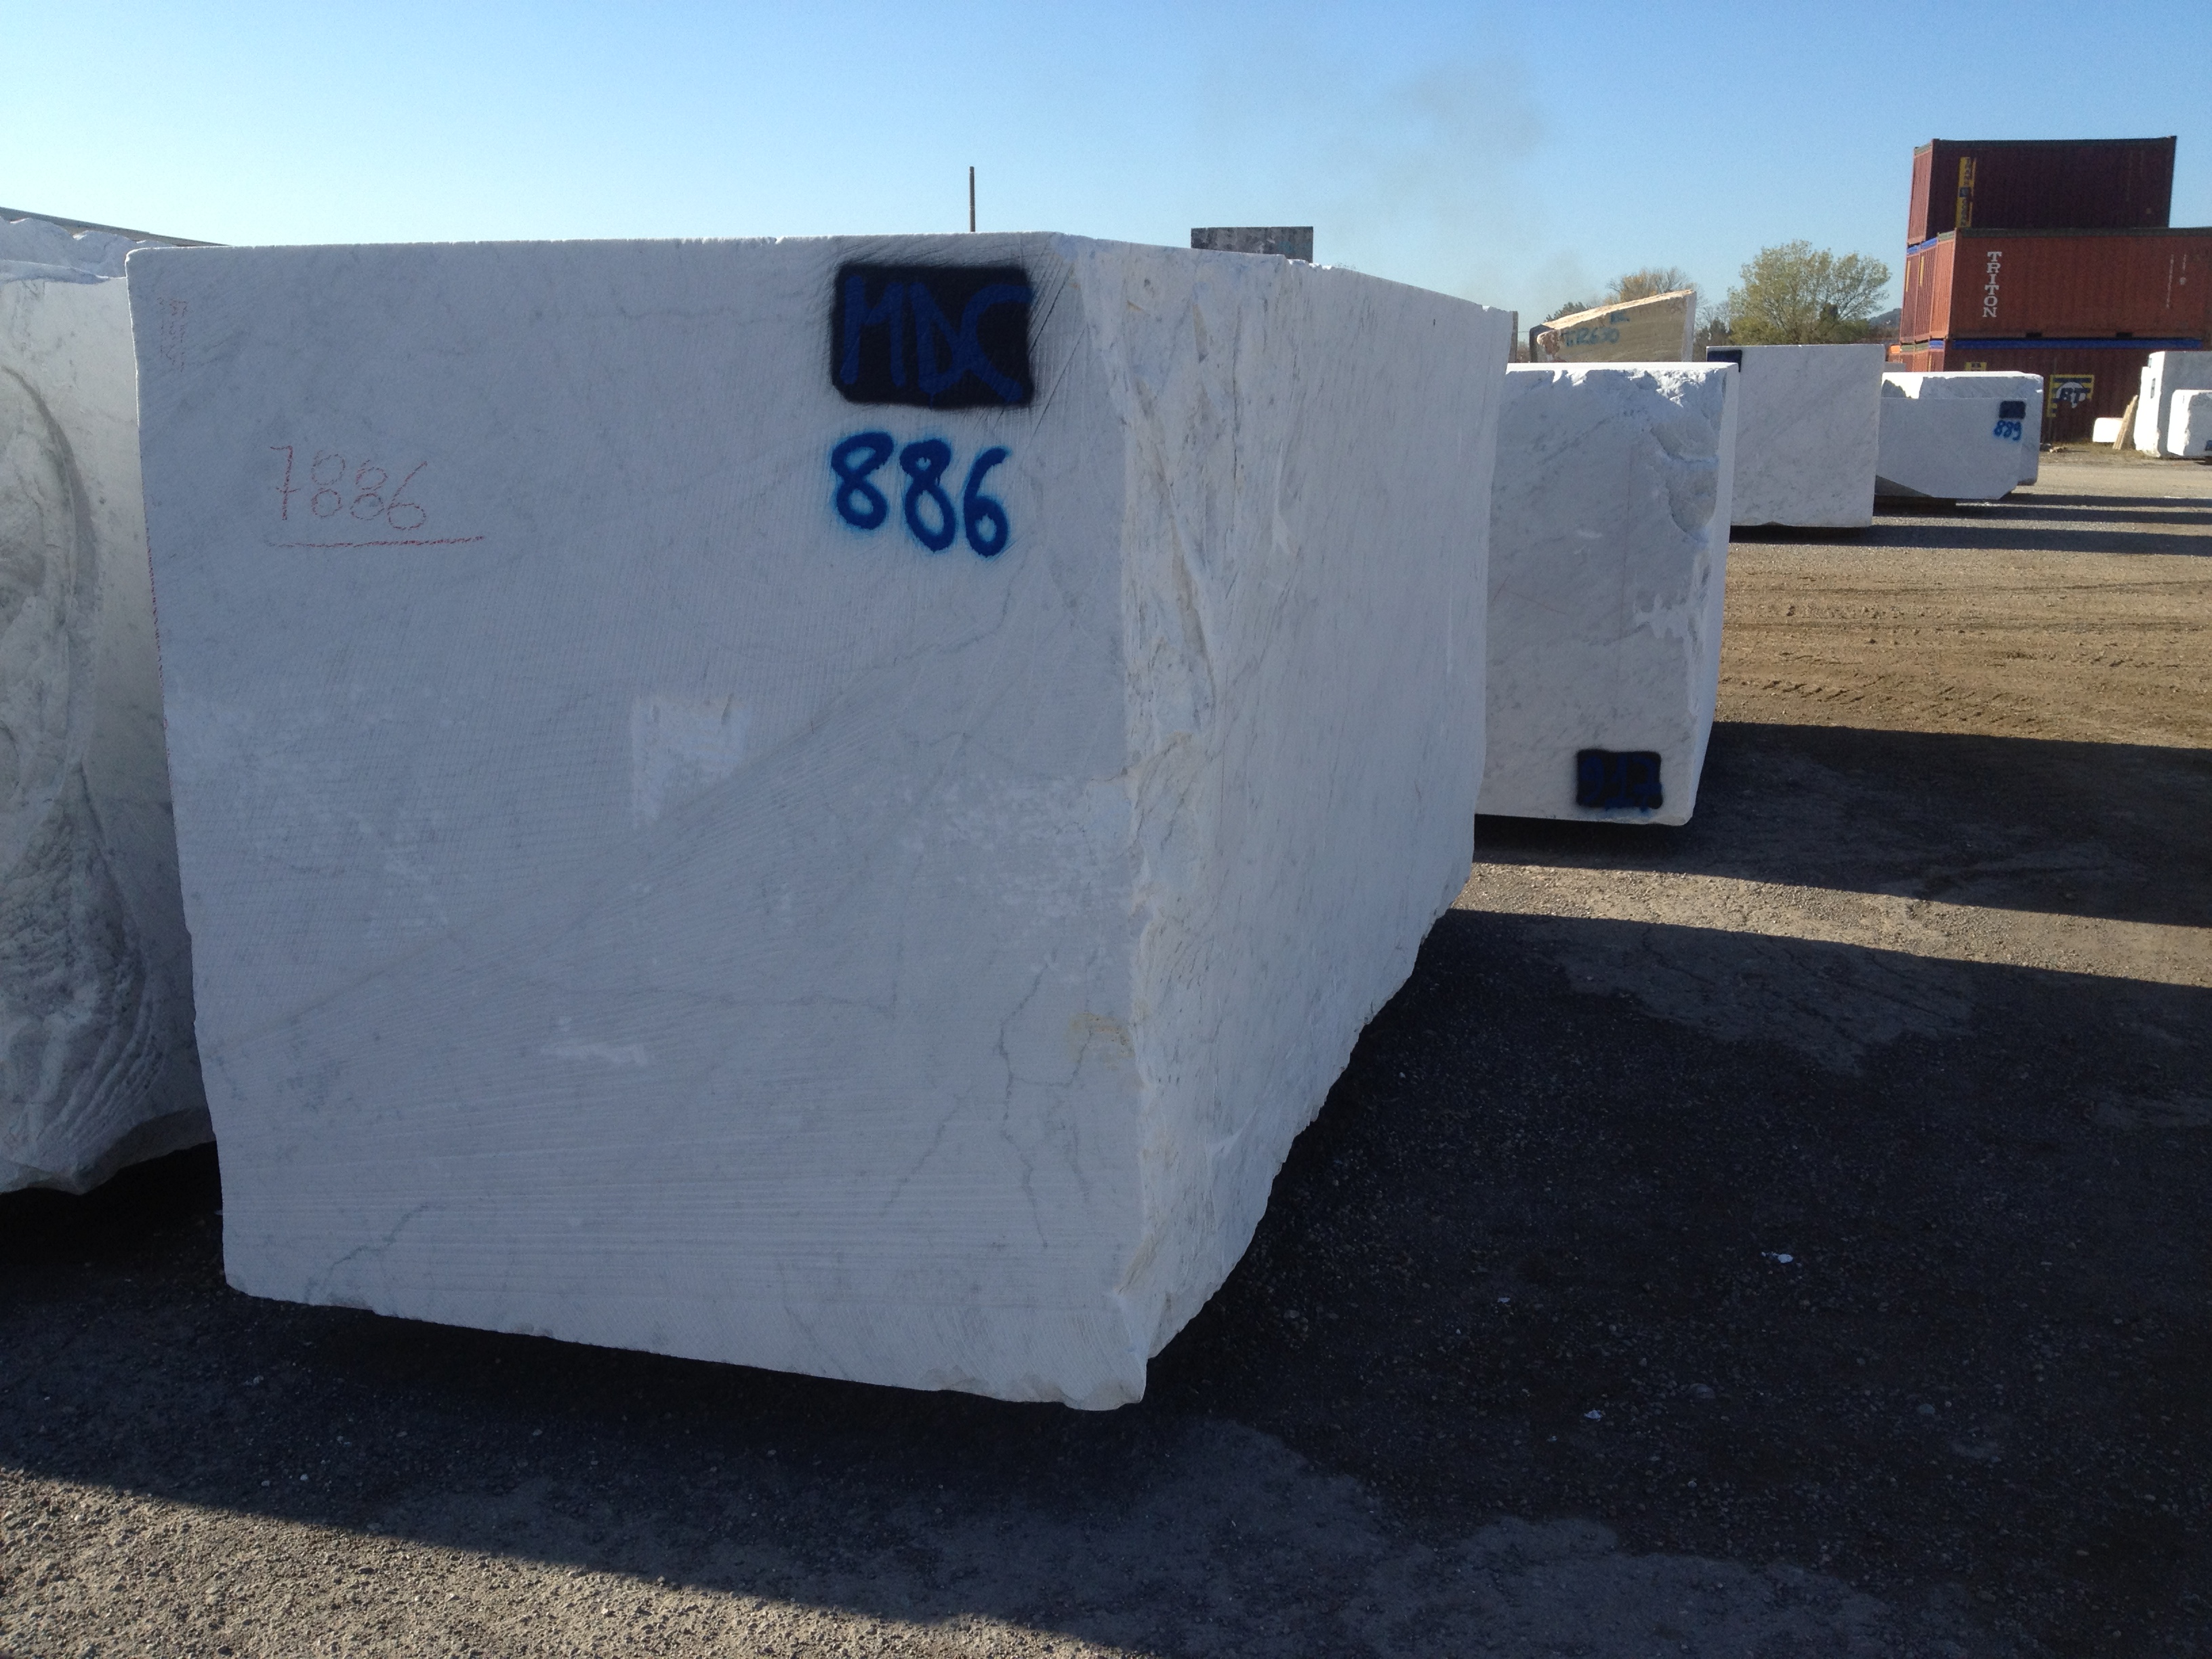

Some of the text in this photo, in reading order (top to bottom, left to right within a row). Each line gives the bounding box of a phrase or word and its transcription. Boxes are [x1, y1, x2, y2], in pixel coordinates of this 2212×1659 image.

[1982, 251, 2002, 318] TRITON
[1993, 419, 2022, 442] 889
[830, 430, 1012, 559] 886
